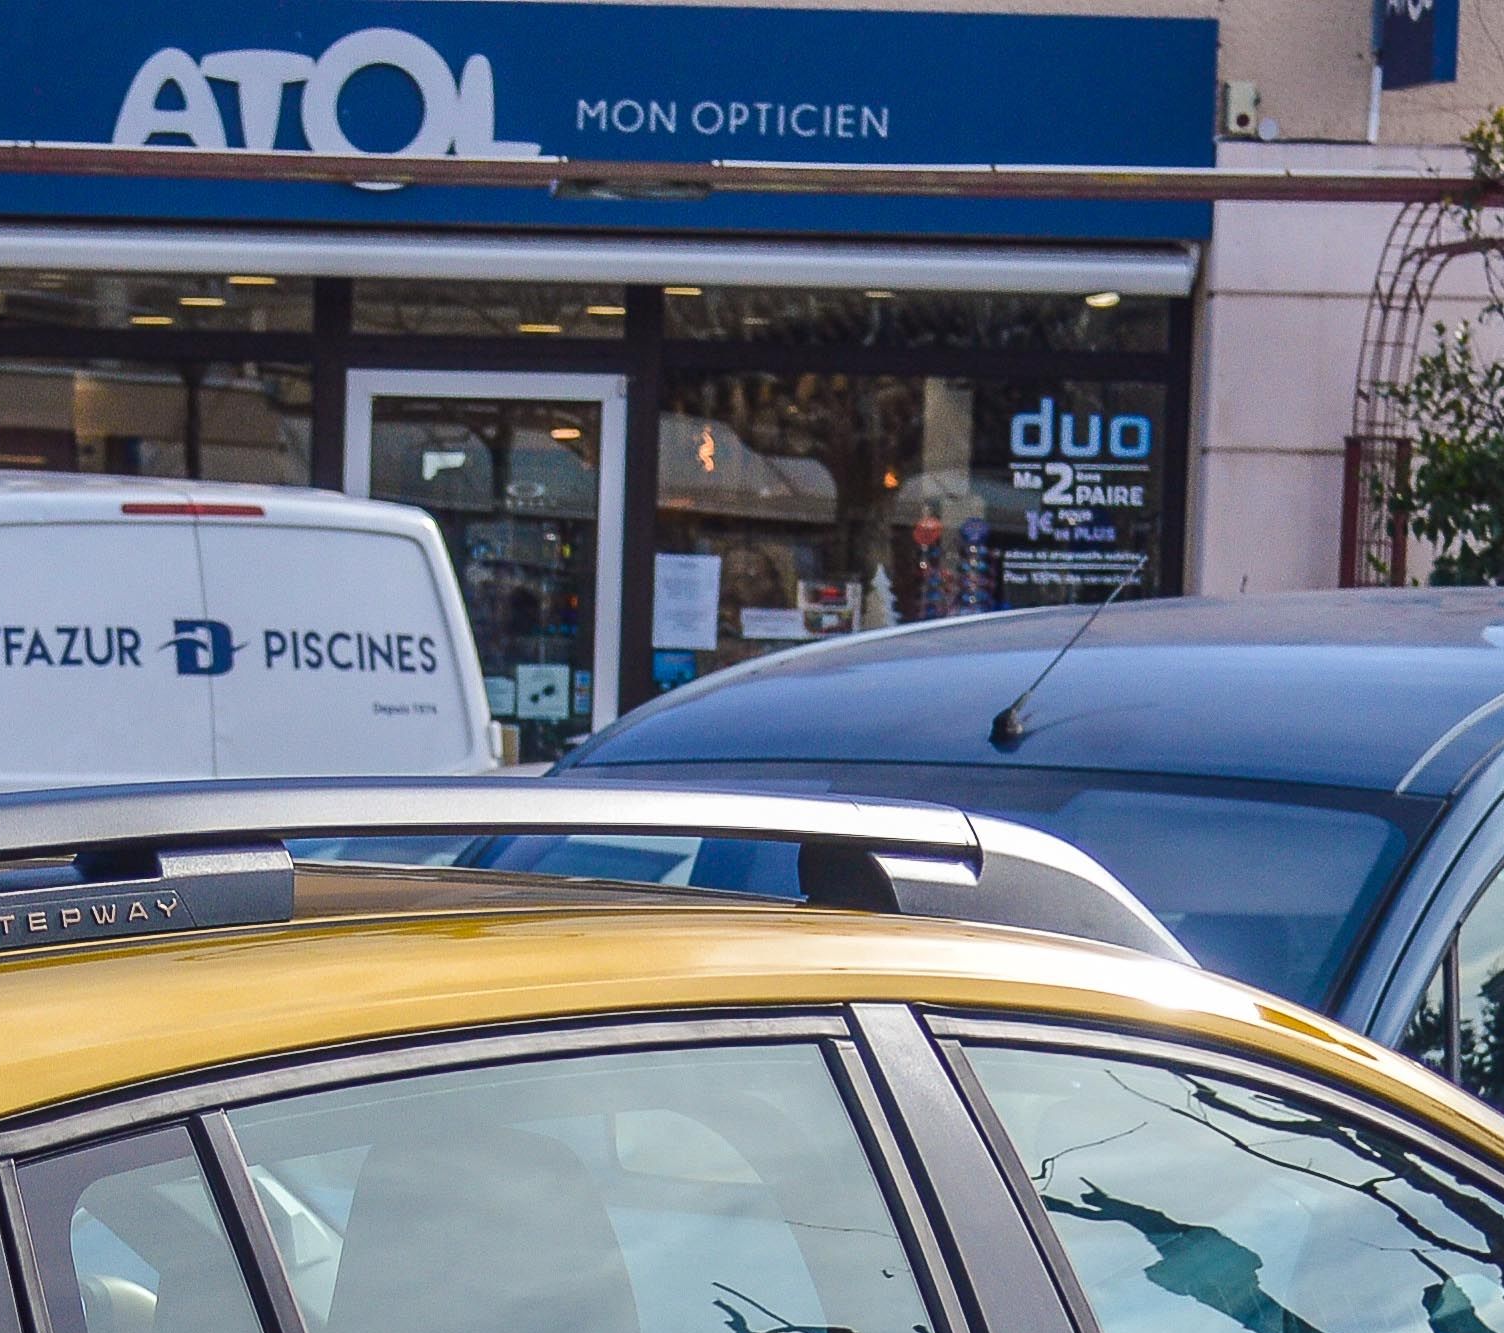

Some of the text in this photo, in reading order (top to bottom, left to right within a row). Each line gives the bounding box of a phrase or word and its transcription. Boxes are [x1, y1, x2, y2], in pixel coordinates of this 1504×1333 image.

[112, 27, 541, 190] ATOL
[576, 98, 891, 139] MON OPTICIEN
[1010, 396, 1153, 458] duo
[1043, 461, 1074, 506] 2
[1075, 485, 1145, 507] PAIRE
[264, 629, 438, 675] PISCINES
